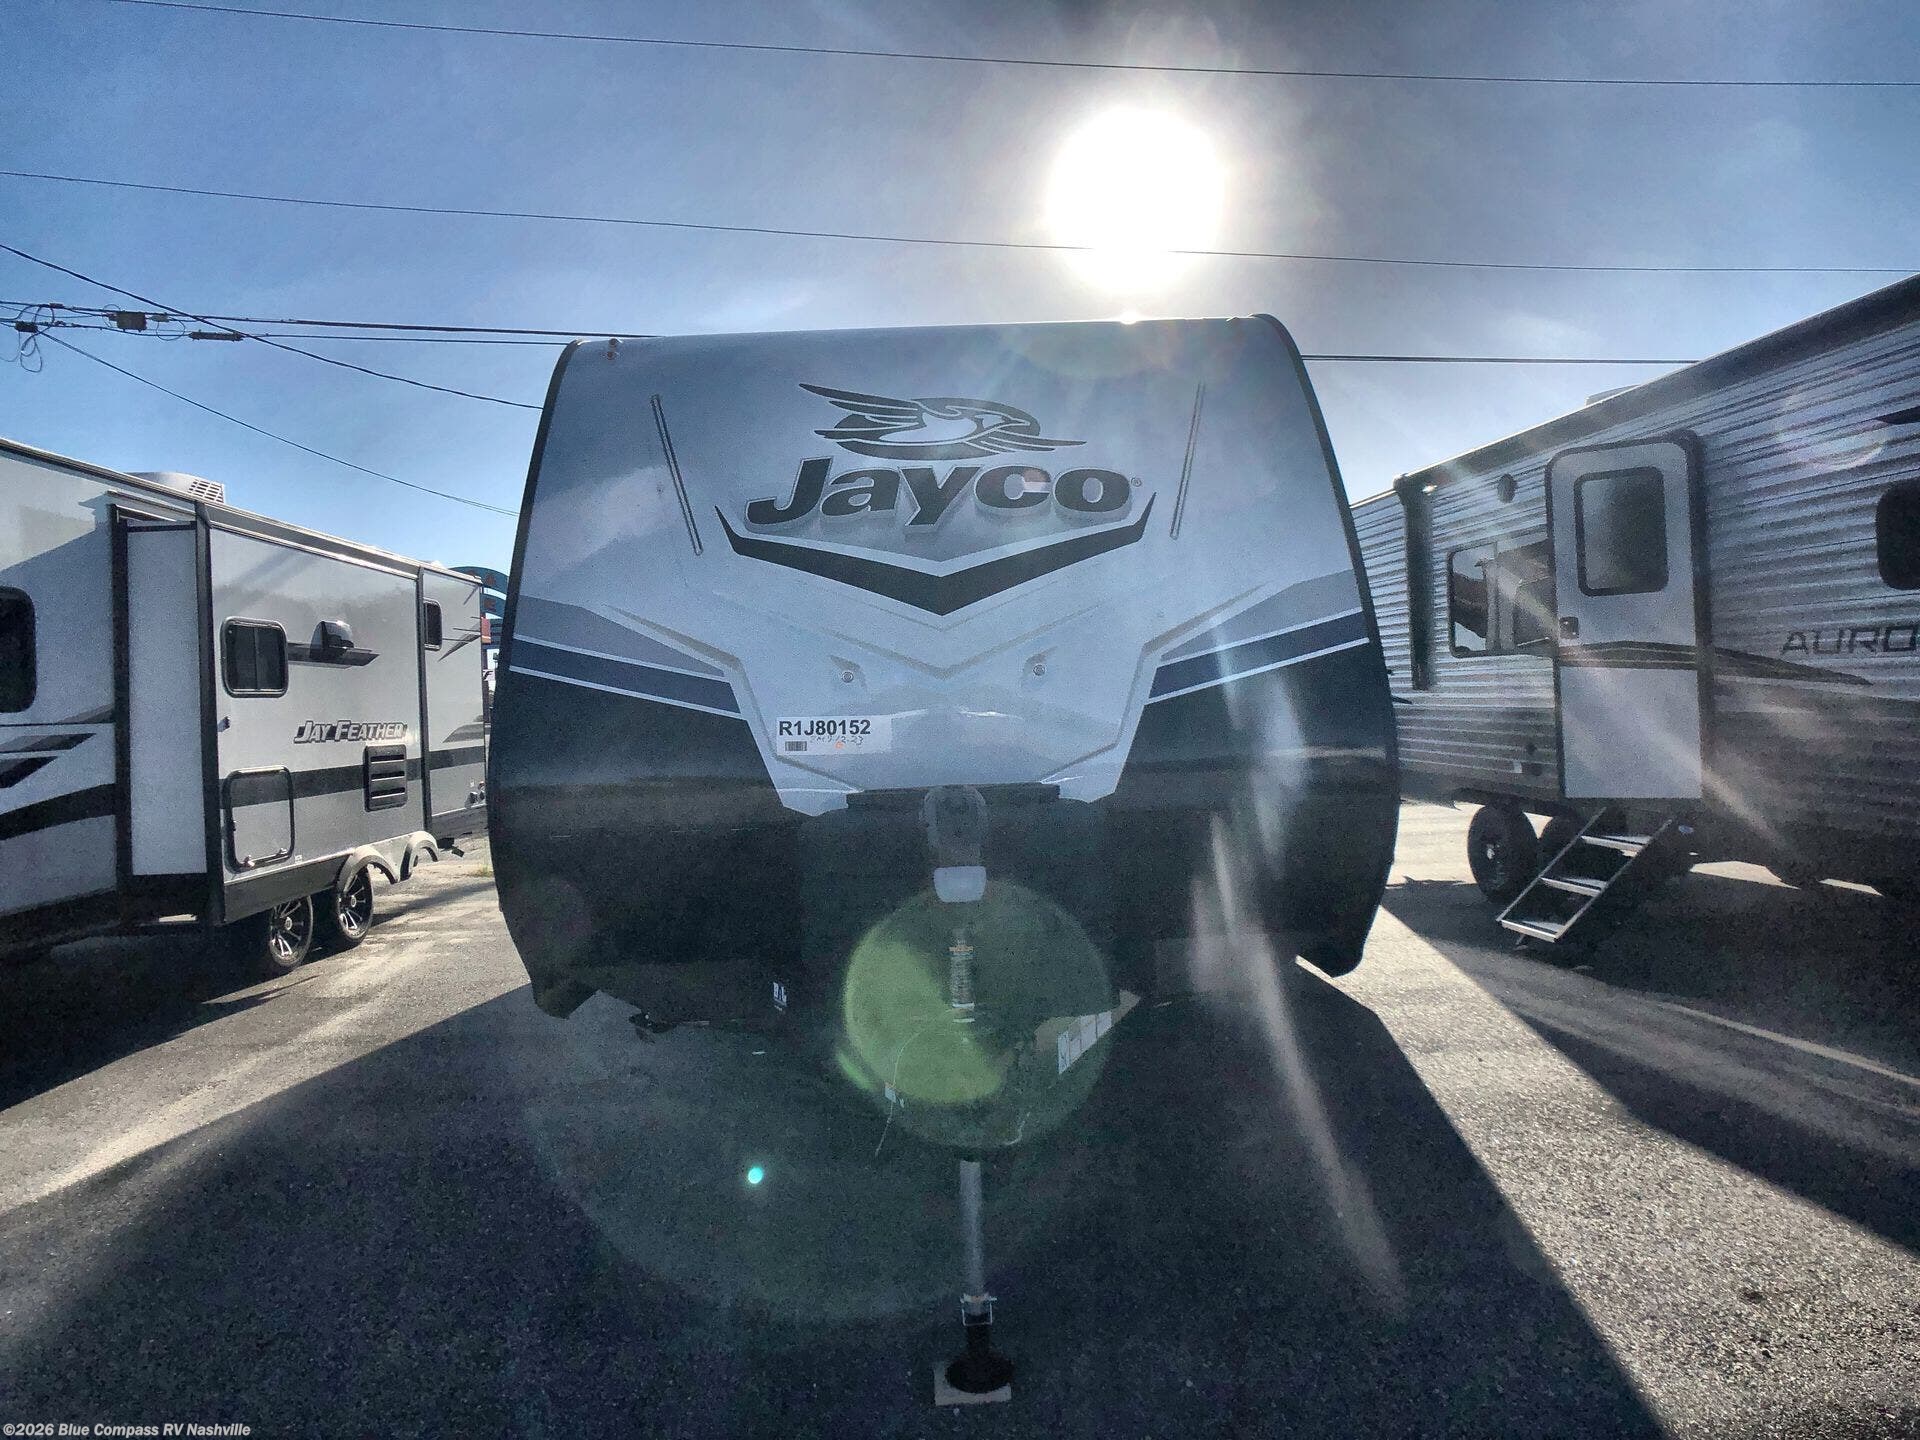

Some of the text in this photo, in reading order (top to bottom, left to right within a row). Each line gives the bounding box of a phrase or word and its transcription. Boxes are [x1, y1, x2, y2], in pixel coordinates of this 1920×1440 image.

[745, 457, 1131, 527] Jayco
[294, 720, 407, 743] JAY FEATHER
[779, 719, 871, 736] R1J80152
